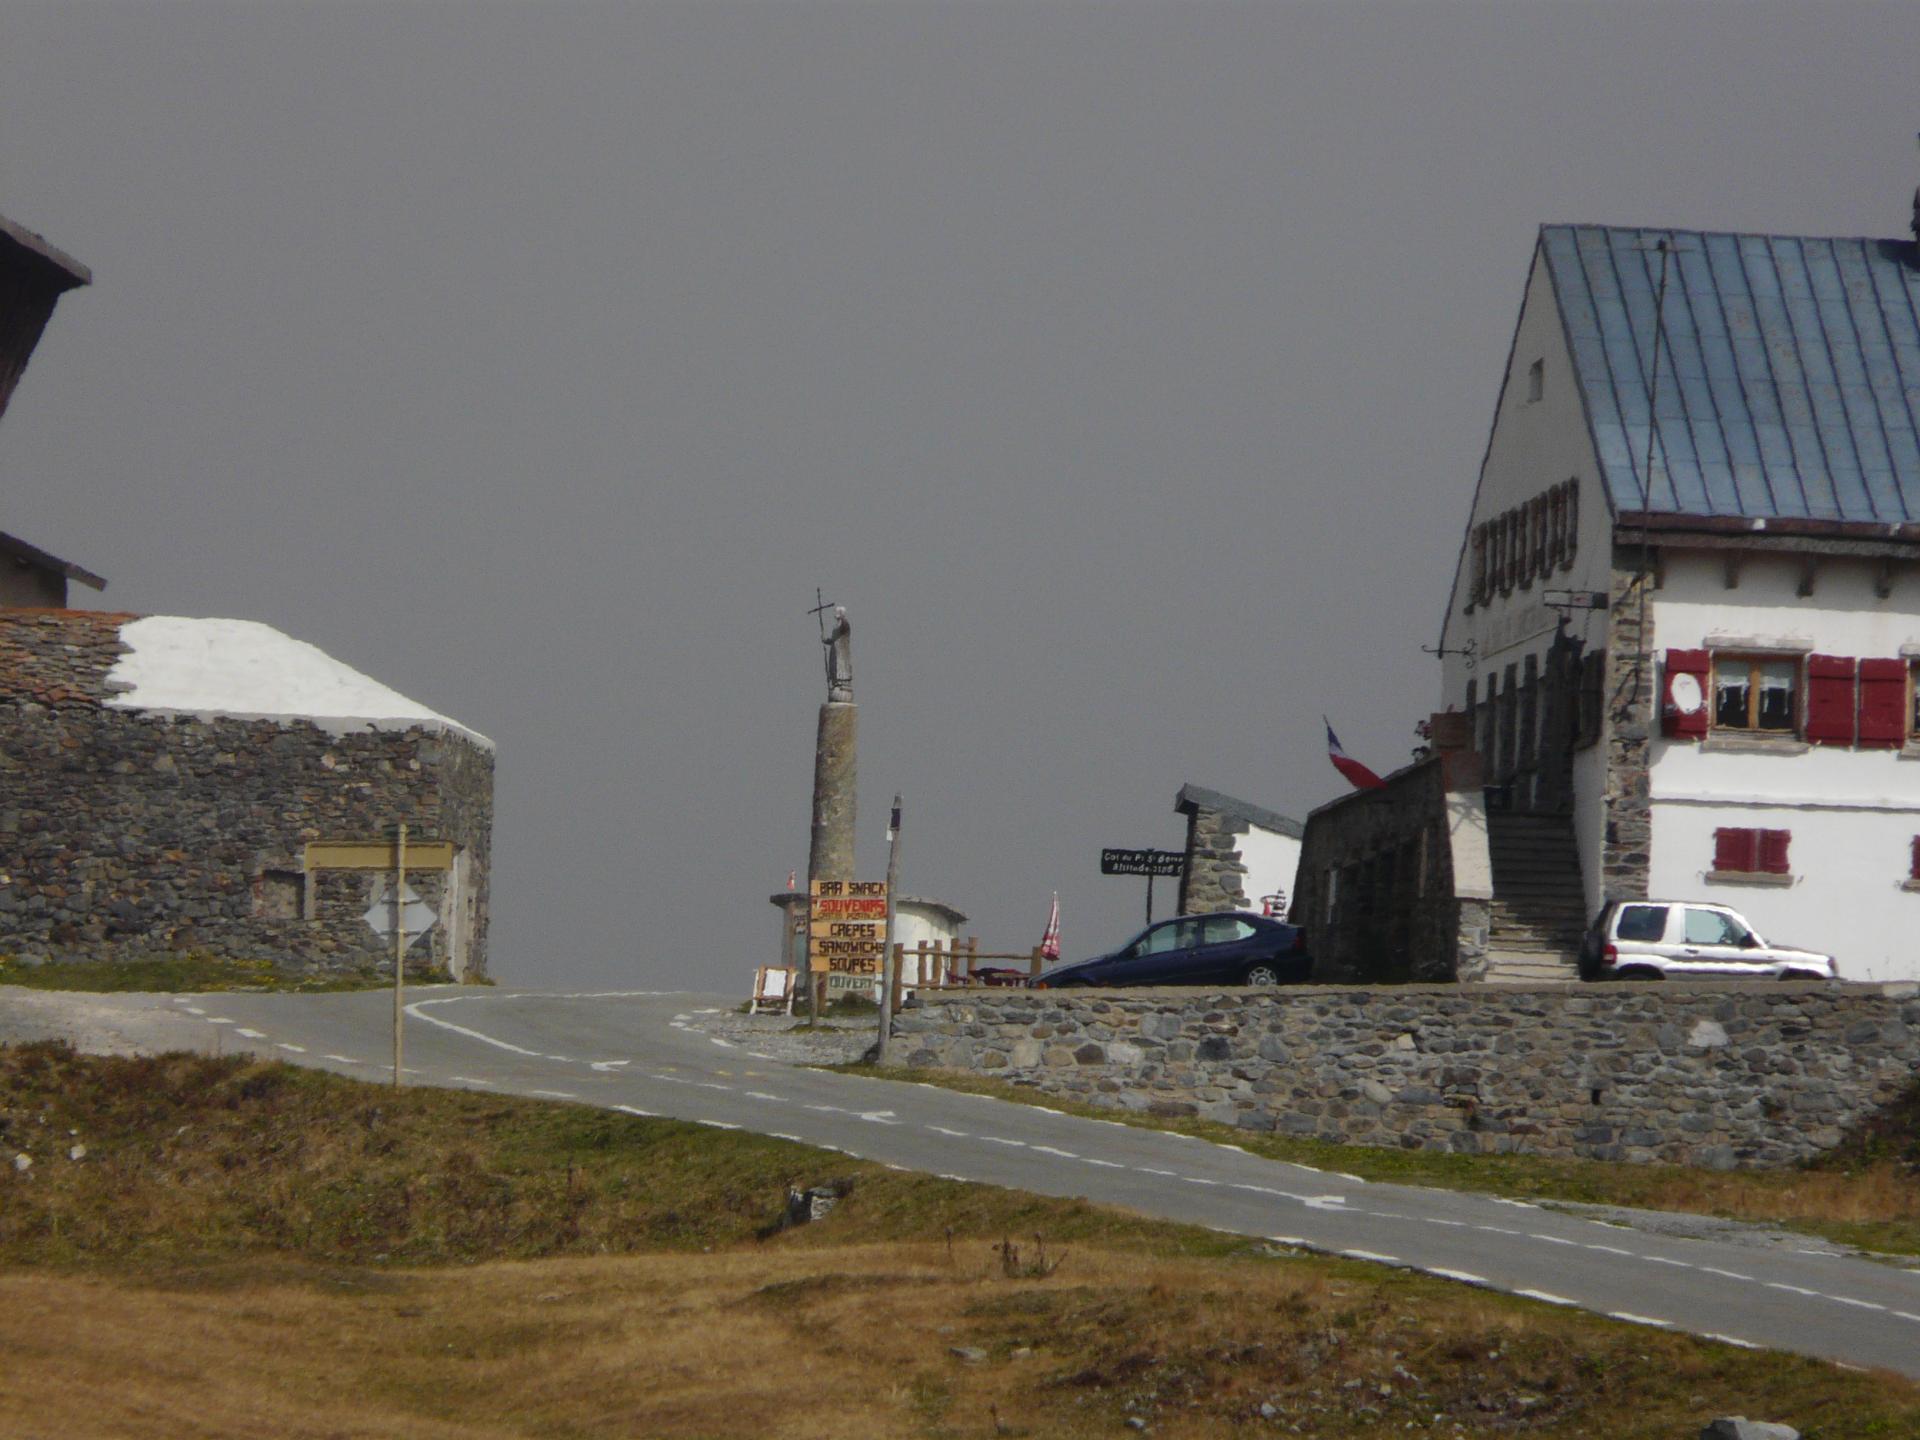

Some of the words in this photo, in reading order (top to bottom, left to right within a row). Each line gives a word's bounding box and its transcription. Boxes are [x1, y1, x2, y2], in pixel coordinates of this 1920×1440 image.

[1104, 852, 1120, 861] Col
[820, 881, 842, 895] BAR
[848, 882, 885, 895] SNACK
[820, 899, 886, 913] SOUVENIRS
[830, 923, 876, 937] CREPES
[819, 940, 885, 955] SANDWICHS
[829, 958, 876, 972] SOUPES
[829, 975, 873, 989] OUVERT
